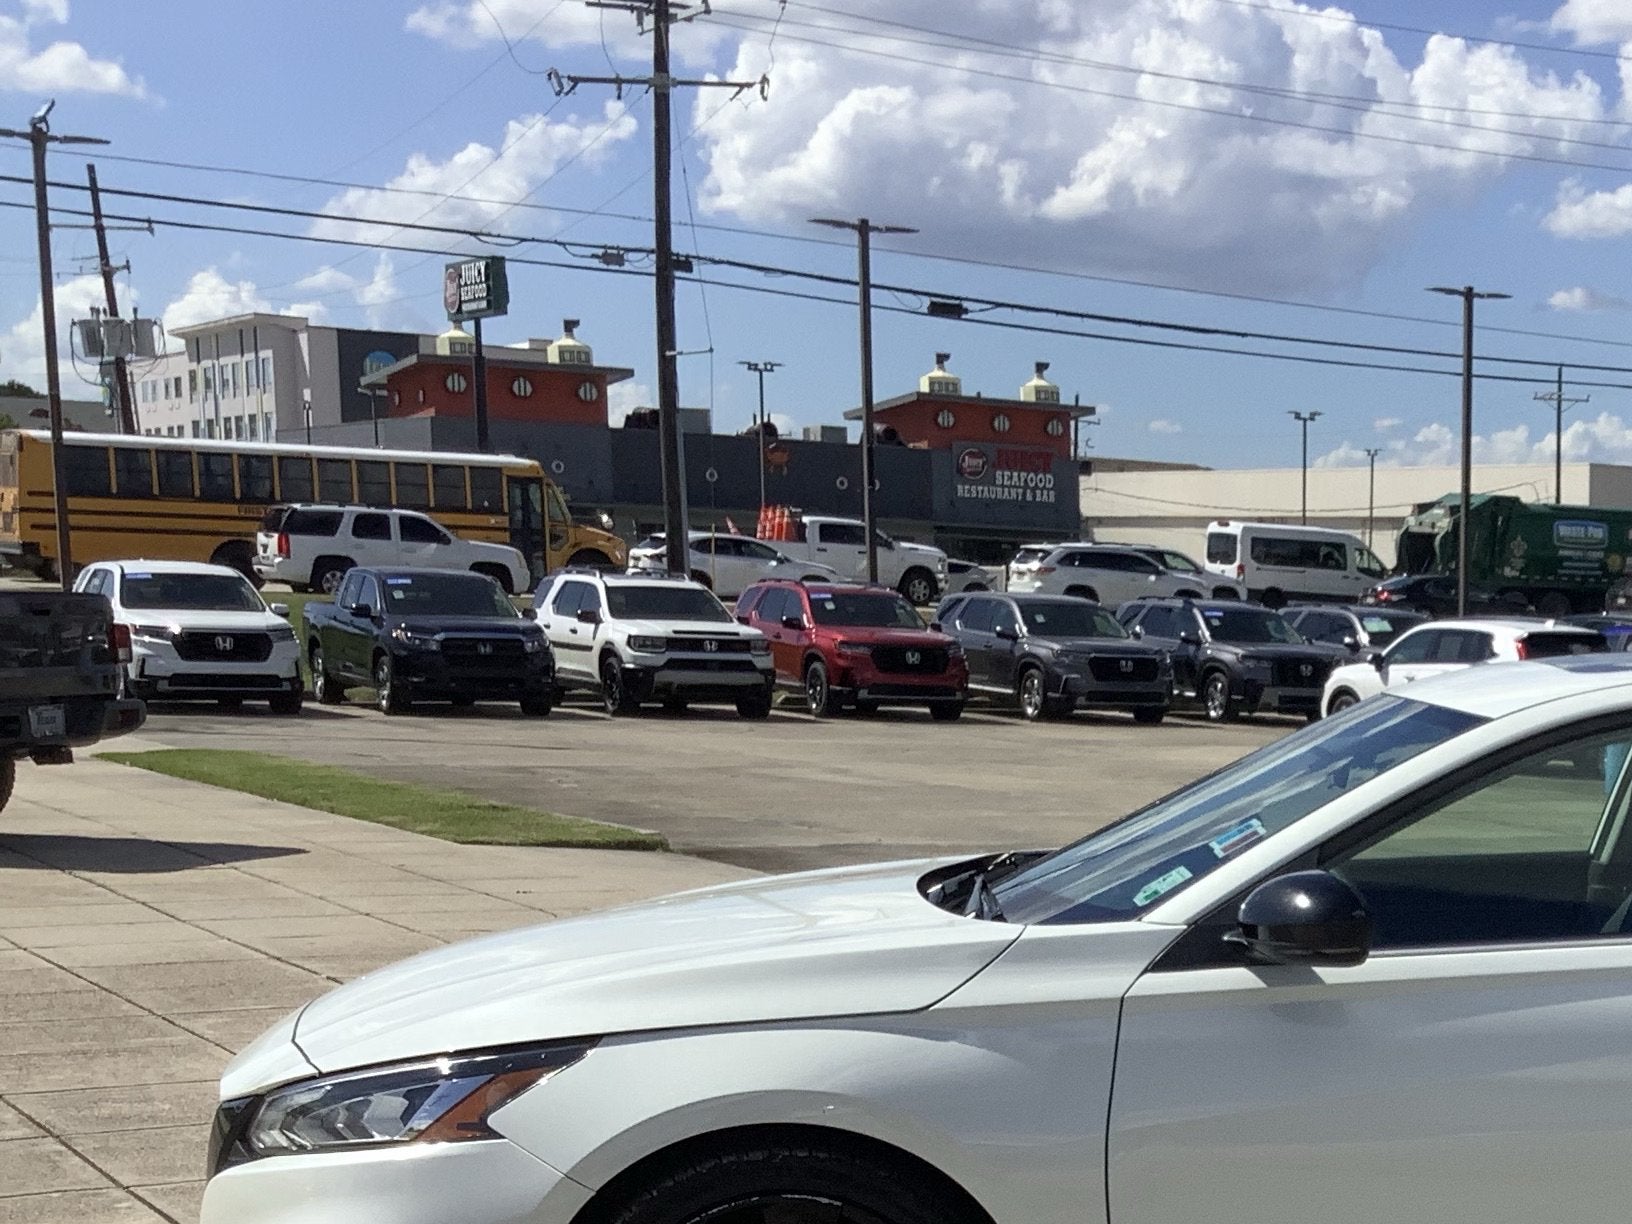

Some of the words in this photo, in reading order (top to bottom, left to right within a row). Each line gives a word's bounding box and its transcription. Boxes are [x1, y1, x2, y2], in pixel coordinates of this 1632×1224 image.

[460, 261, 486, 285] JUICY
[461, 283, 487, 300] SEAFOOD
[995, 470, 1054, 488] SEAFOOD
[957, 484, 1023, 501] RESTAURANT
[1025, 489, 1034, 501] &
[1036, 490, 1056, 503] BAR
